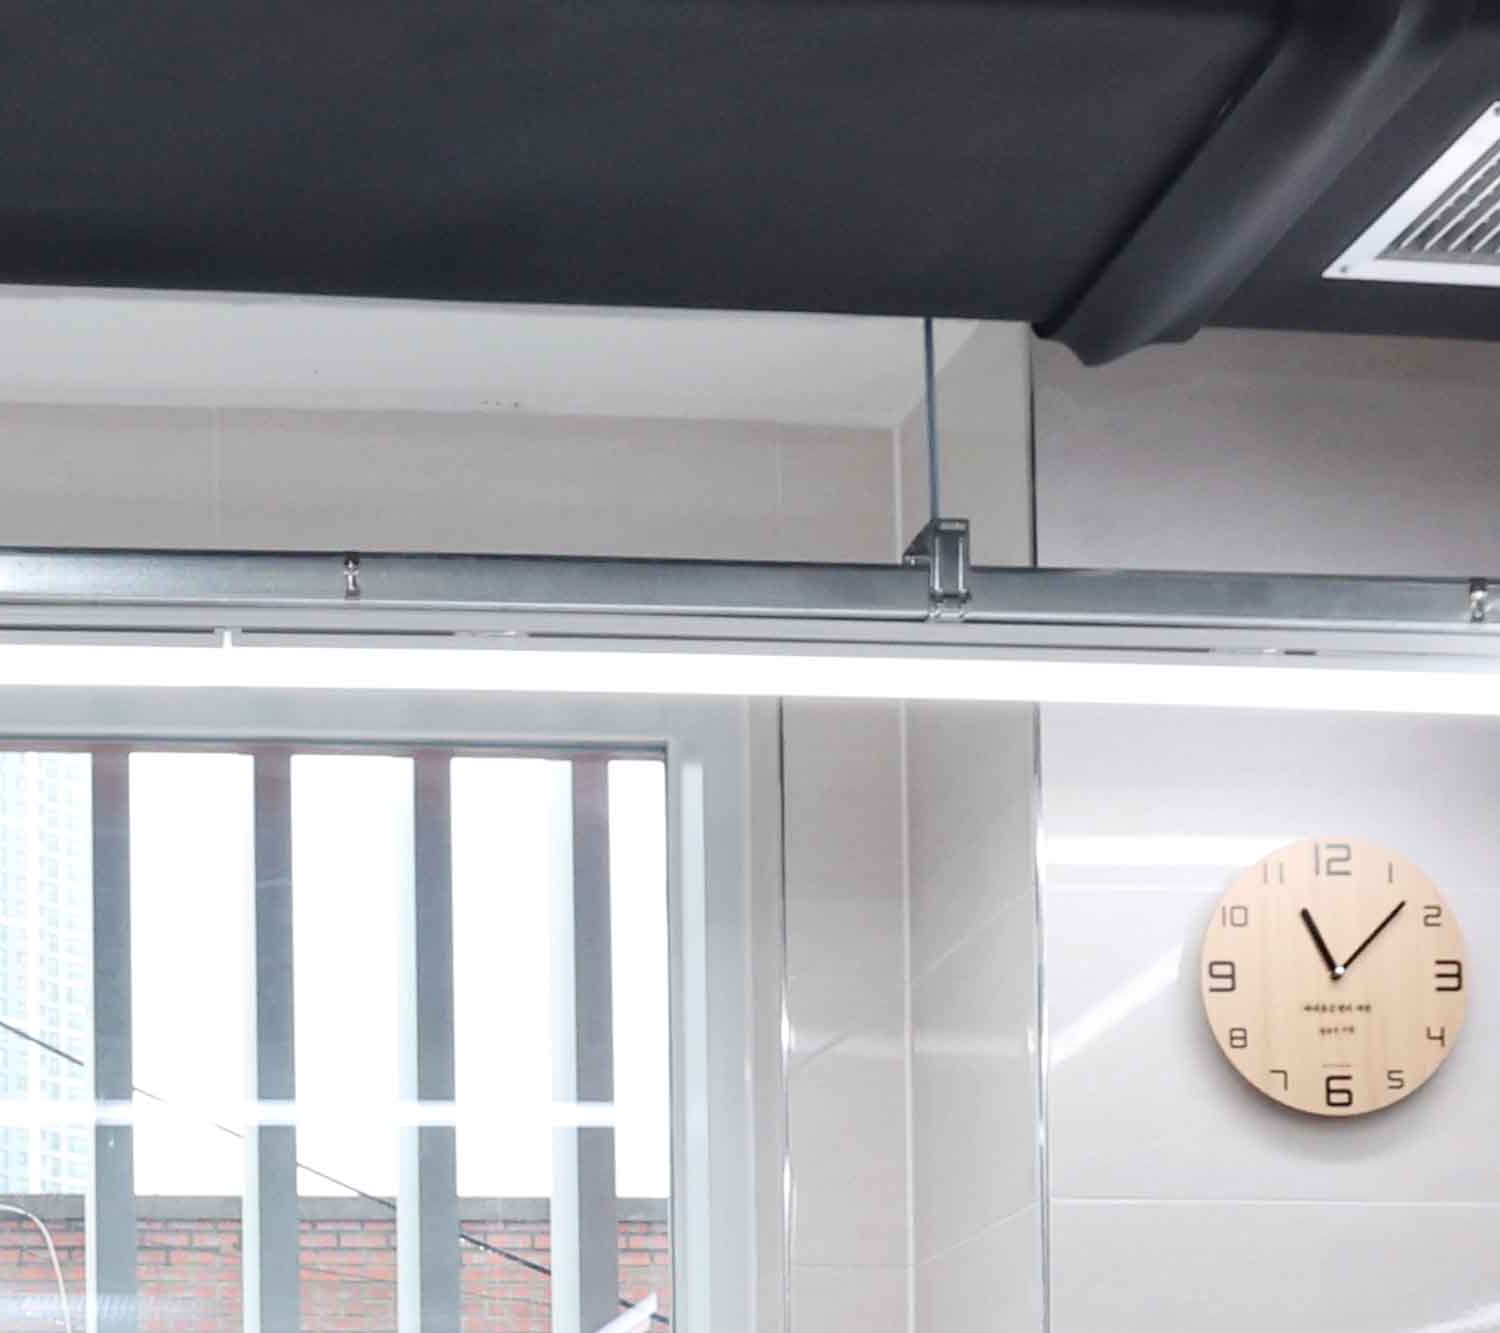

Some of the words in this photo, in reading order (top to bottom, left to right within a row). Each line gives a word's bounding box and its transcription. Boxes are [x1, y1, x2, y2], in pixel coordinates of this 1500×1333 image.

[1314, 844, 1352, 876] 12
[1263, 863, 1284, 884] 11
[1386, 862, 1394, 884] 1
[1221, 905, 1249, 928] 10
[1423, 905, 1442, 928] 2
[1208, 960, 1237, 993] 9
[1434, 959, 1464, 992] 3
[1229, 1027, 1249, 1049] 8
[1425, 1026, 1447, 1048] 4
[1269, 1069, 1289, 1091] 7
[1325, 1074, 1354, 1107] 6
[1386, 1069, 1405, 1090] 5
